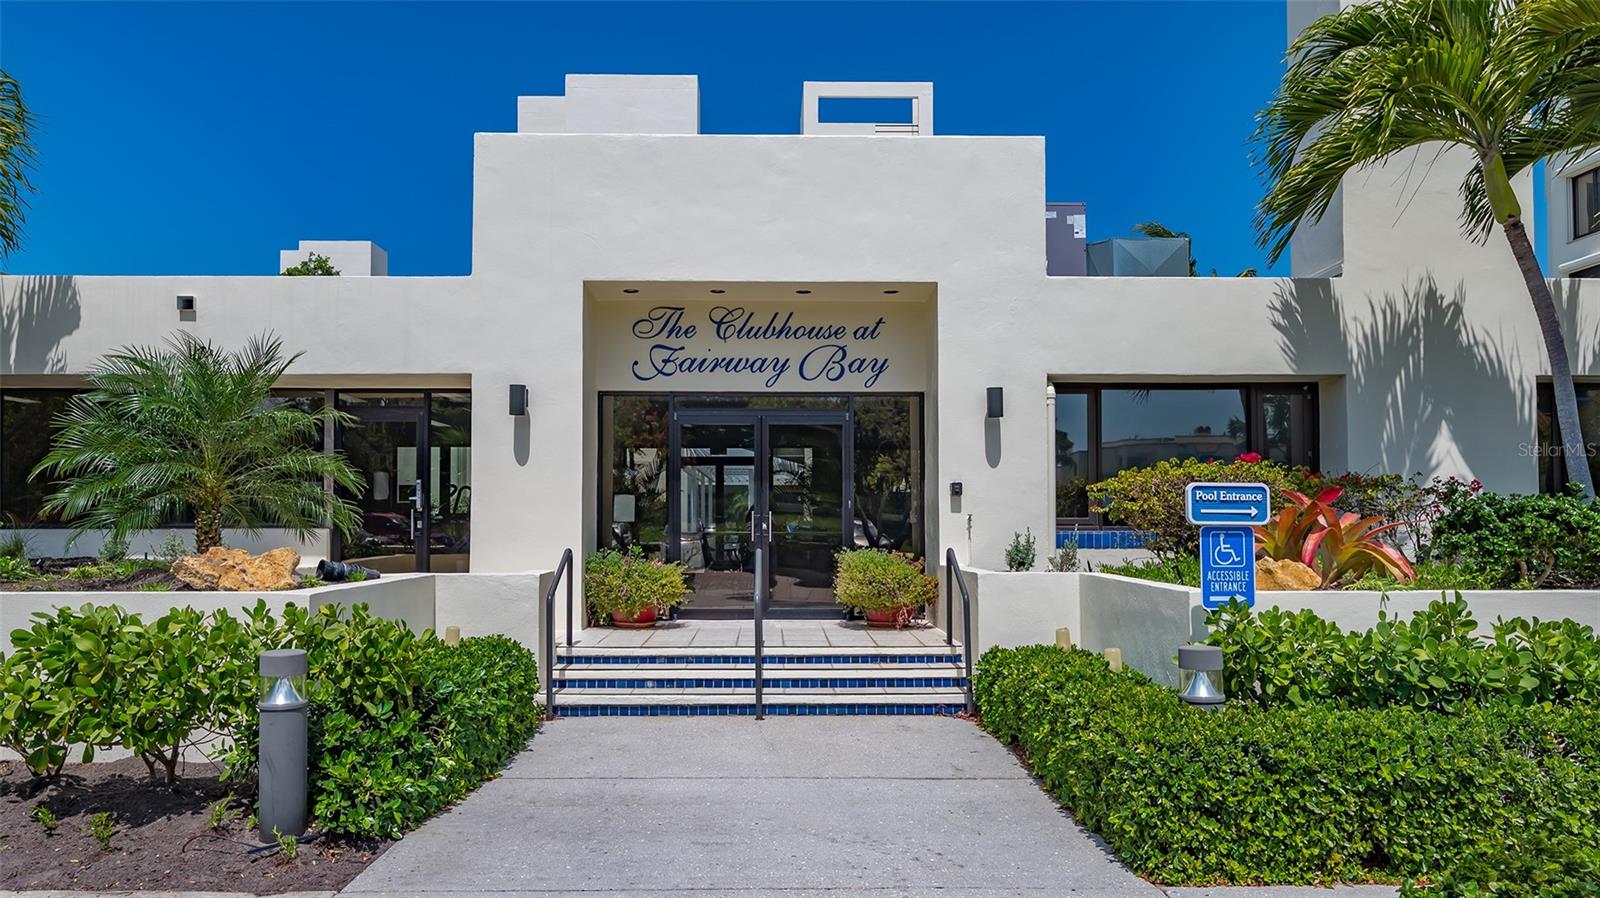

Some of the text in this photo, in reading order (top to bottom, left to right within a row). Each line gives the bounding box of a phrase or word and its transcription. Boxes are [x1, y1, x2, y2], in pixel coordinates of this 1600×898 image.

[632, 306, 886, 343] The Clubhouse at
[632, 344, 889, 388] Fairway Bay
[1195, 490, 1263, 501] Pool Entrance
[1207, 571, 1249, 581] ACCESSIBLE
[1210, 582, 1247, 592] ENTRANCE
